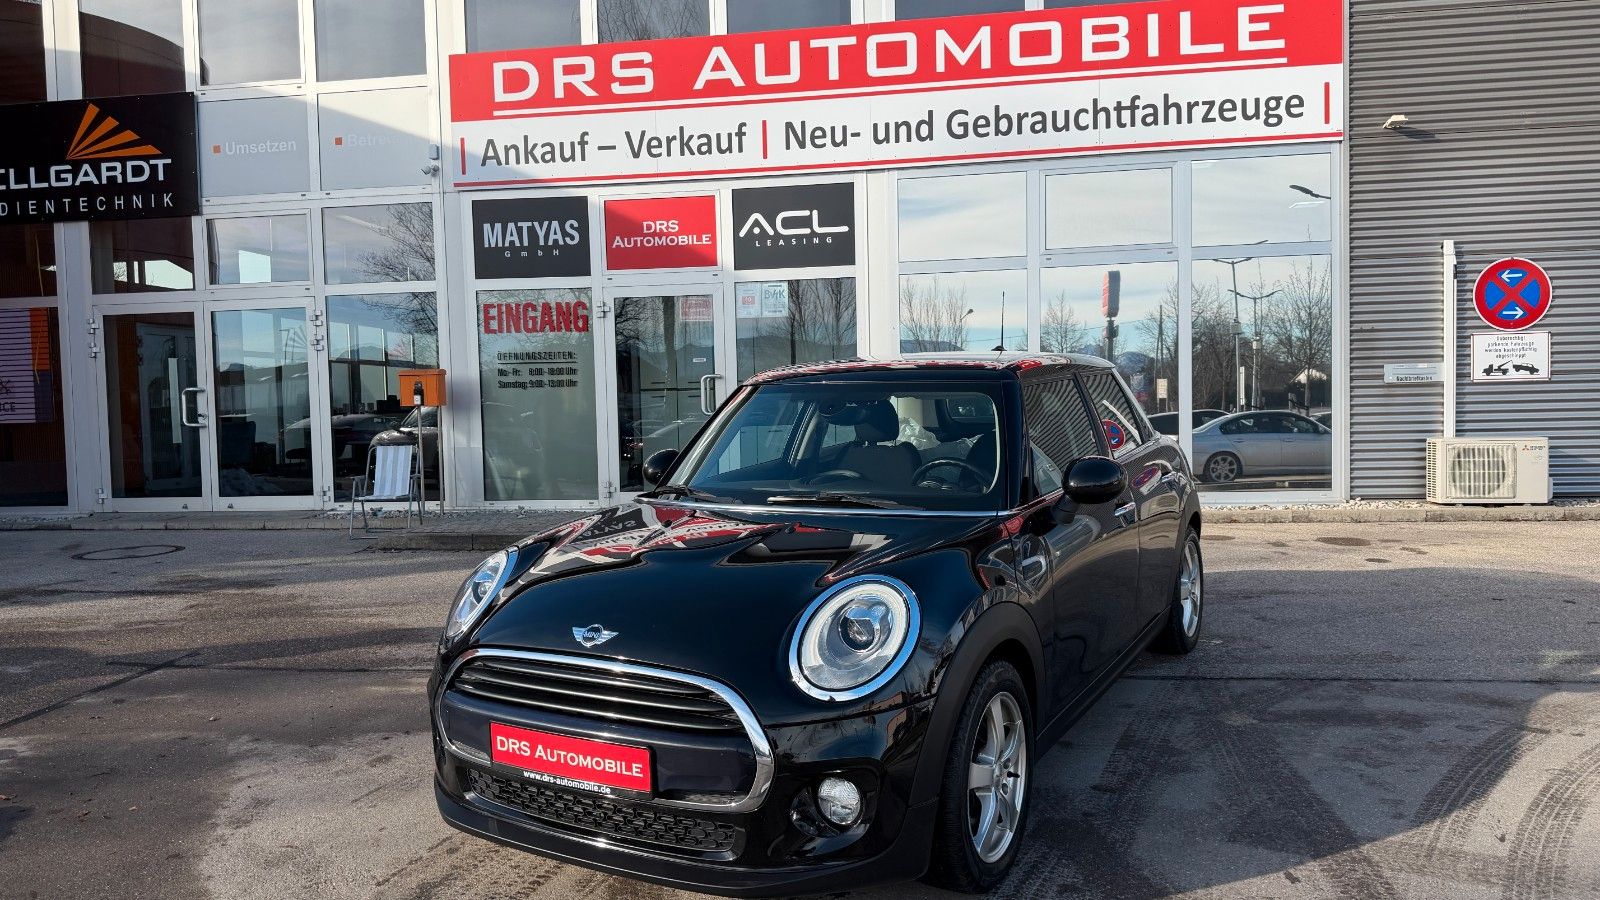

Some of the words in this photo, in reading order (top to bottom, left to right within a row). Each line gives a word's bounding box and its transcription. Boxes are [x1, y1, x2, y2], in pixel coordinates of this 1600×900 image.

[493, 51, 654, 102] DRS
[692, 3, 1286, 90] AUTOMOBILE
[480, 131, 590, 167] Ankauf
[624, 121, 748, 159] Verkauf
[784, 120, 861, 151] Neu-
[872, 110, 934, 145] und
[946, 93, 1305, 139] Gebrauchtfahrzeuge
[225, 138, 297, 156] Umsetzen
[483, 219, 580, 248] MATYAS
[642, 219, 679, 234] DRS
[738, 209, 849, 238] ACL
[755, 236, 833, 247] LEASING
[483, 300, 589, 334] EINGANG
[565, 366, 578, 375] Uhr
[565, 379, 578, 388] Uhr
[496, 735, 531, 757] DRS
[523, 770, 611, 794] www.drs-automobile.de
